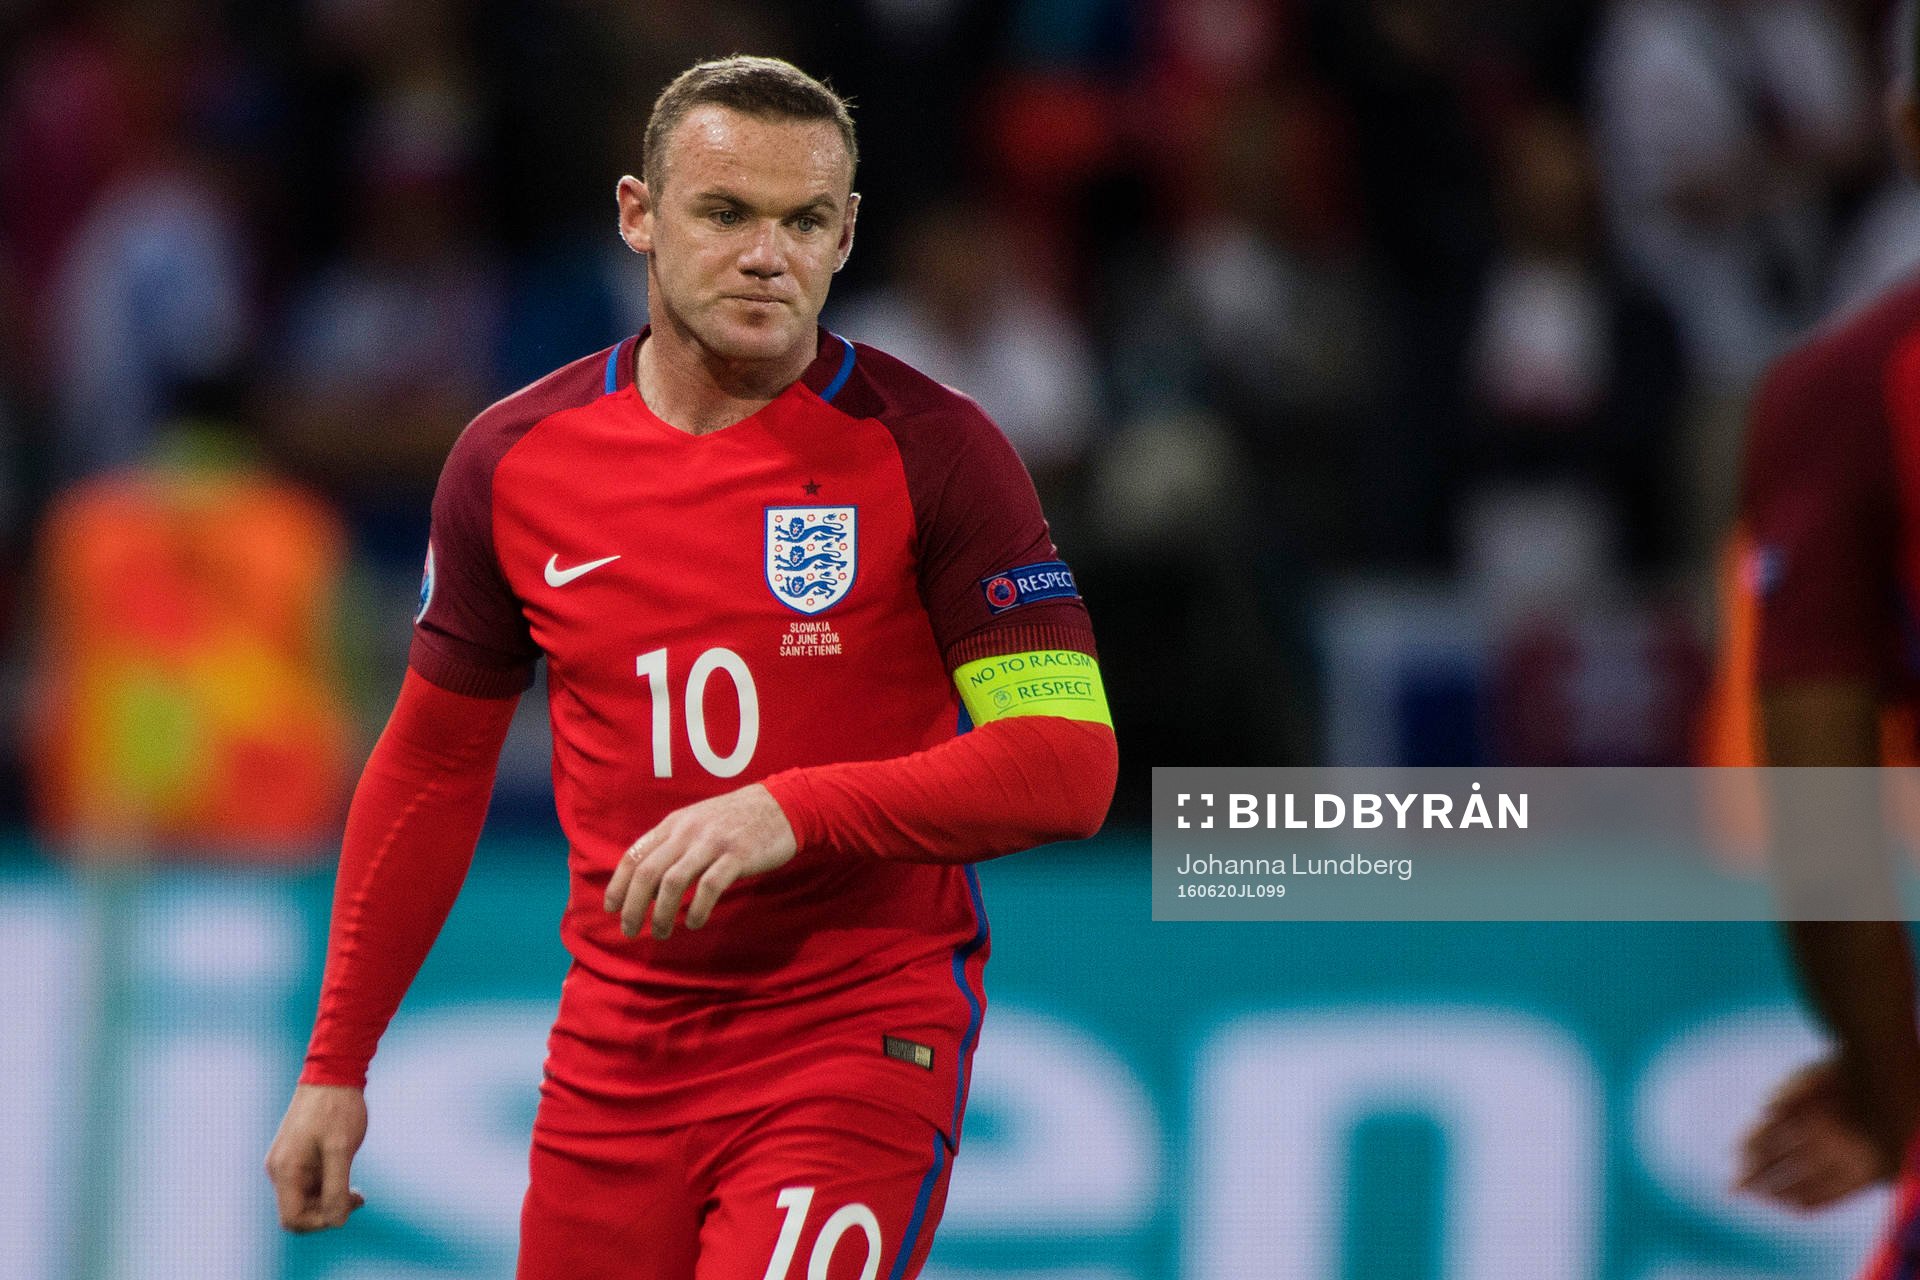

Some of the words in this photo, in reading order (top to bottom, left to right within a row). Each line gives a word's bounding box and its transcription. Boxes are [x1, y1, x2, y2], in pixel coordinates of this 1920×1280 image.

[790, 621, 831, 632] SLOVAKIA
[782, 633, 794, 645] 20
[796, 633, 819, 645] JUNE
[820, 632, 840, 644] 2016
[779, 643, 843, 656] SAINT-ETIENNE
[970, 667, 995, 688] NO
[998, 658, 1025, 674] TO
[1029, 652, 1093, 669] RACISM
[1017, 680, 1092, 699] RESPECT
[636, 646, 760, 779] 10
[762, 1186, 882, 1280] 10
